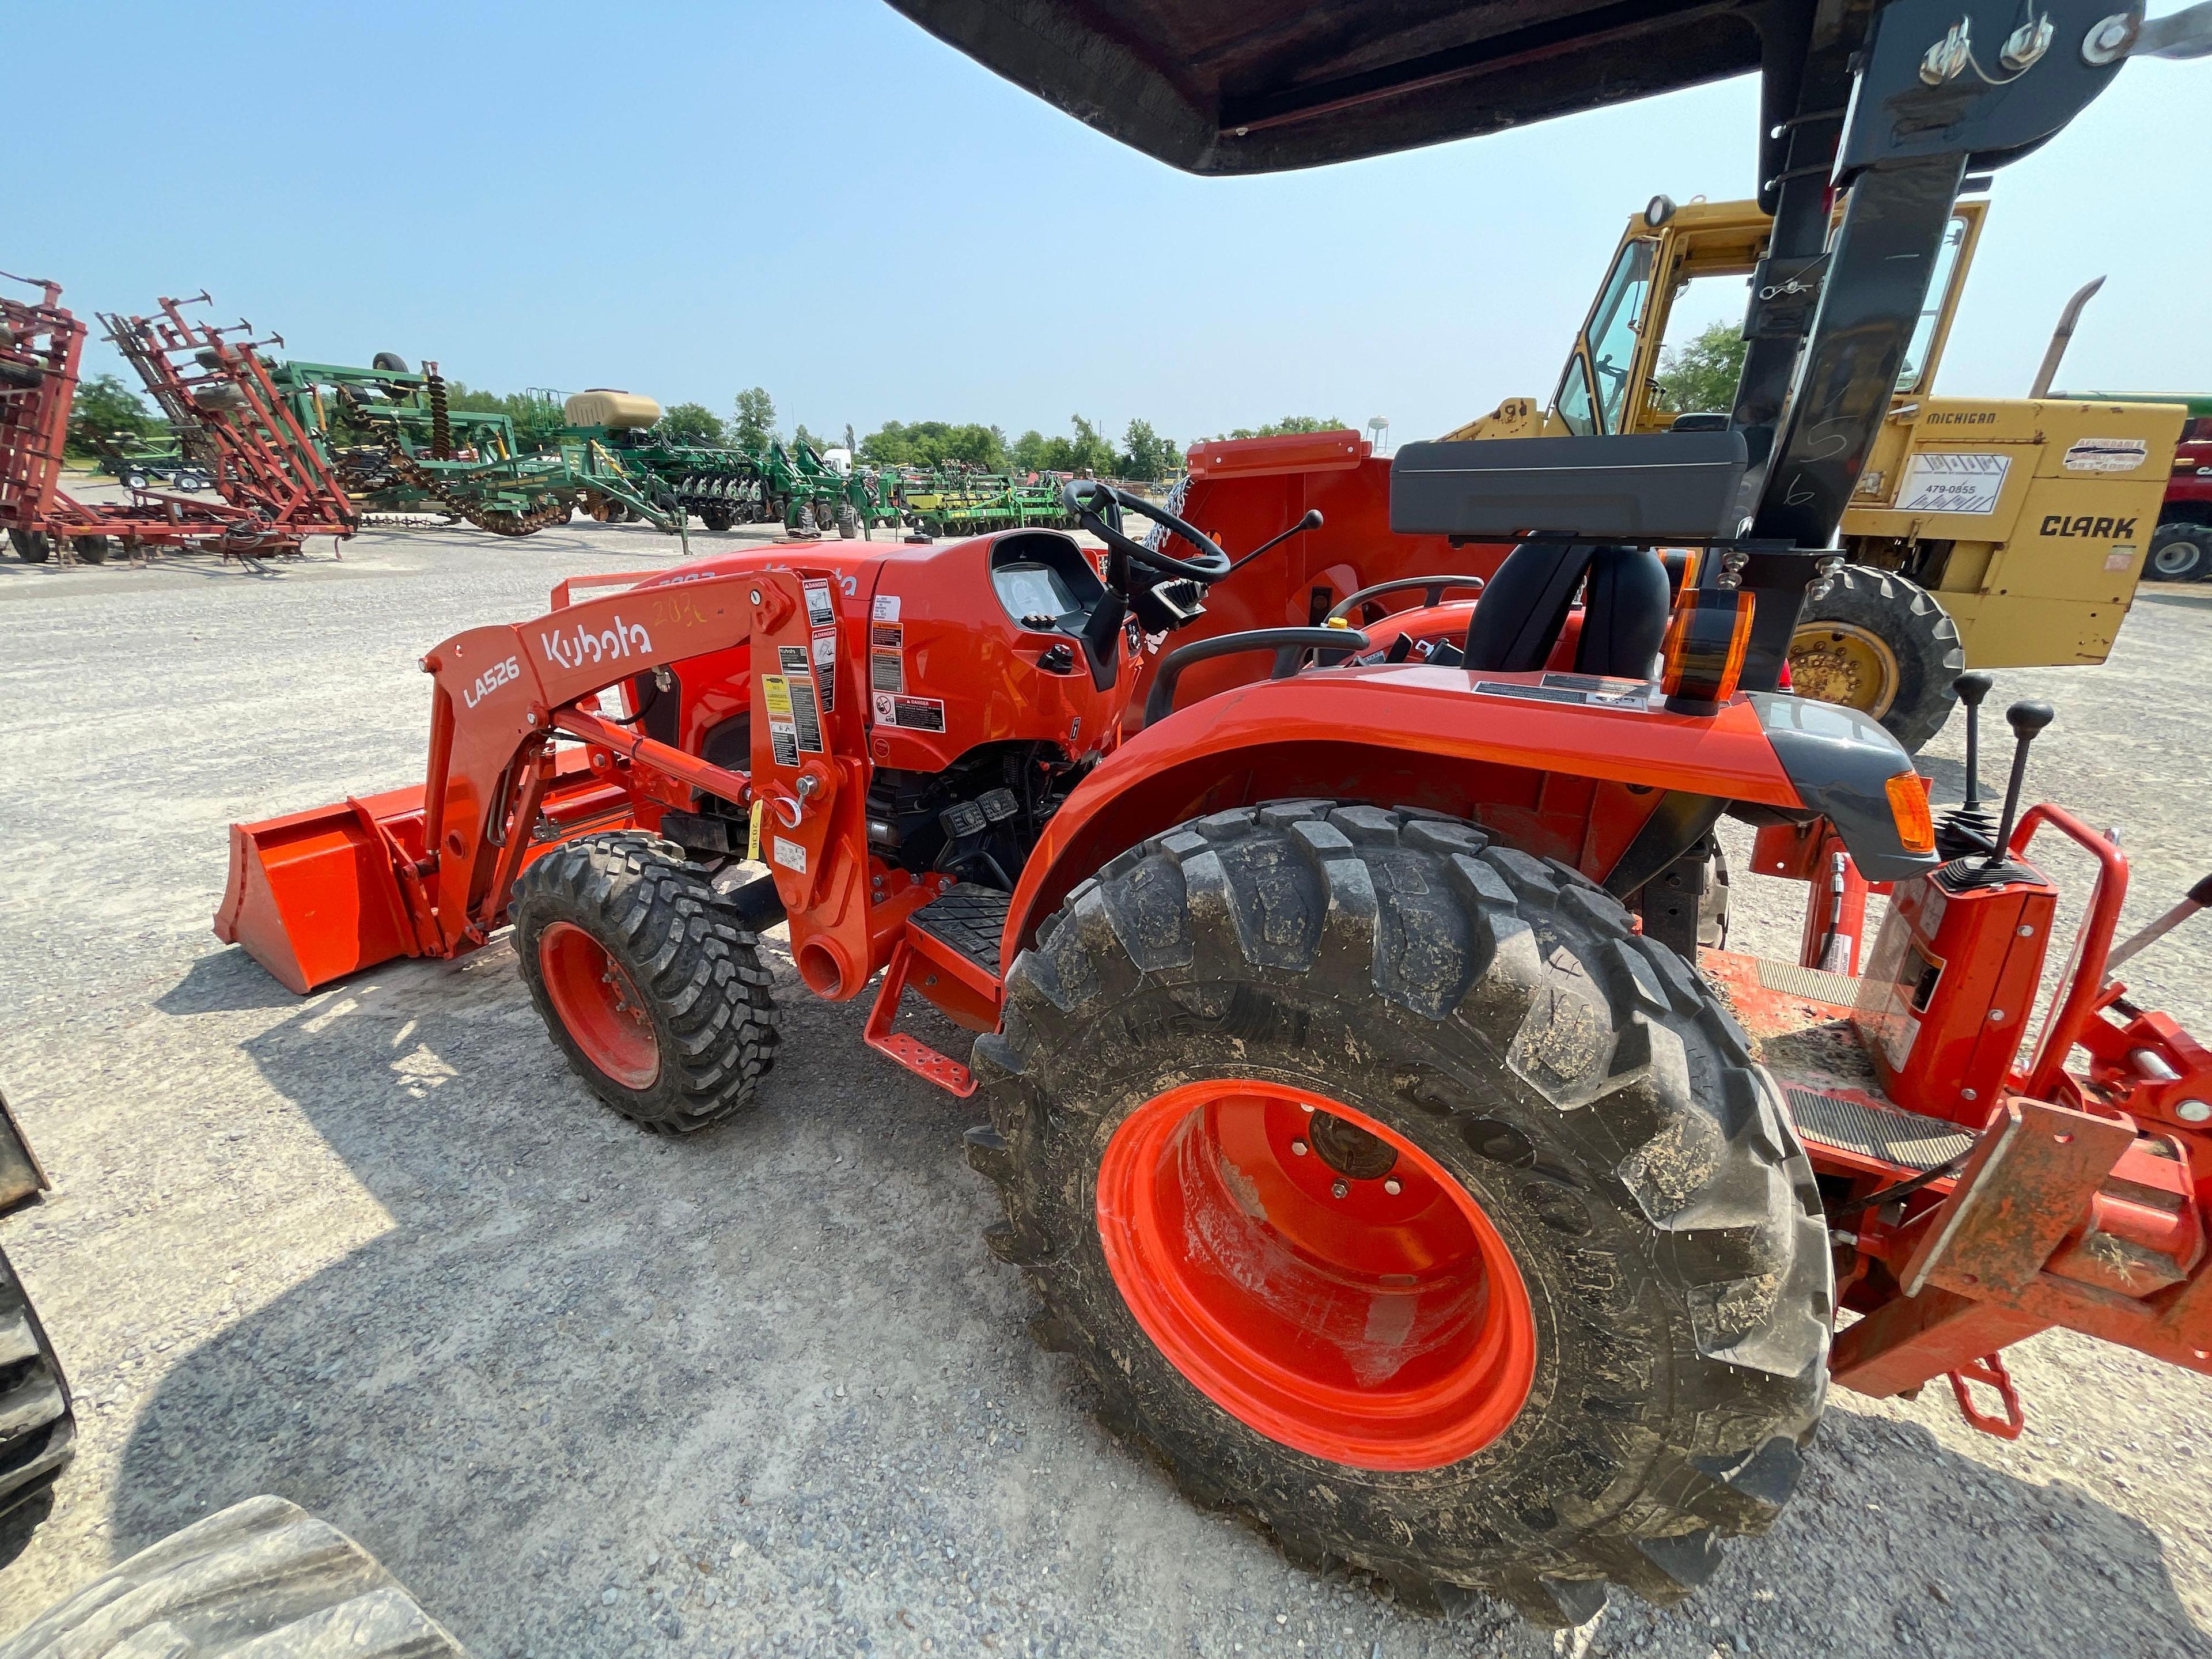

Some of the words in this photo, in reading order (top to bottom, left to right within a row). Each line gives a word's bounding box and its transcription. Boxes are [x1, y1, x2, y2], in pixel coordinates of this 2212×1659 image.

[1927, 412, 1995, 425] MICHIGAN
[1925, 485, 1976, 494] 479-0855
[2040, 516, 2138, 539] CLARK
[541, 615, 652, 669] Kubota
[463, 656, 521, 709] LA526
